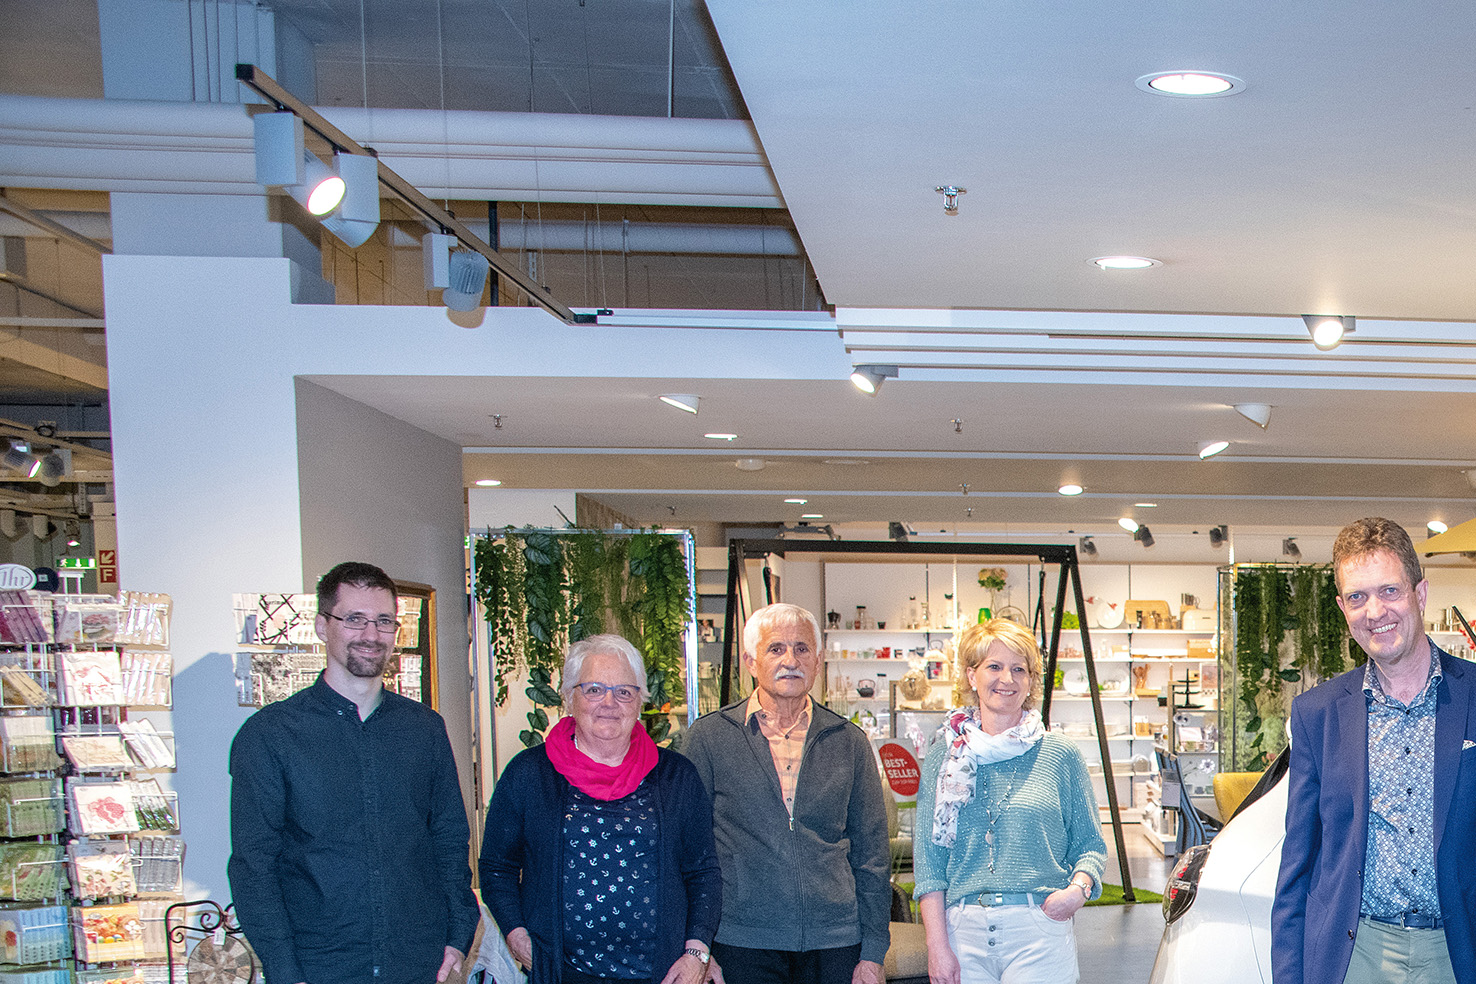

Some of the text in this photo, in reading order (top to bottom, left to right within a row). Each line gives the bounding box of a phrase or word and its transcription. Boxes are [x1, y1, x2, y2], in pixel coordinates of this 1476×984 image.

[102, 568, 113, 582] F
[885, 758, 908, 768] BEST-
[887, 768, 919, 779] SELLER
